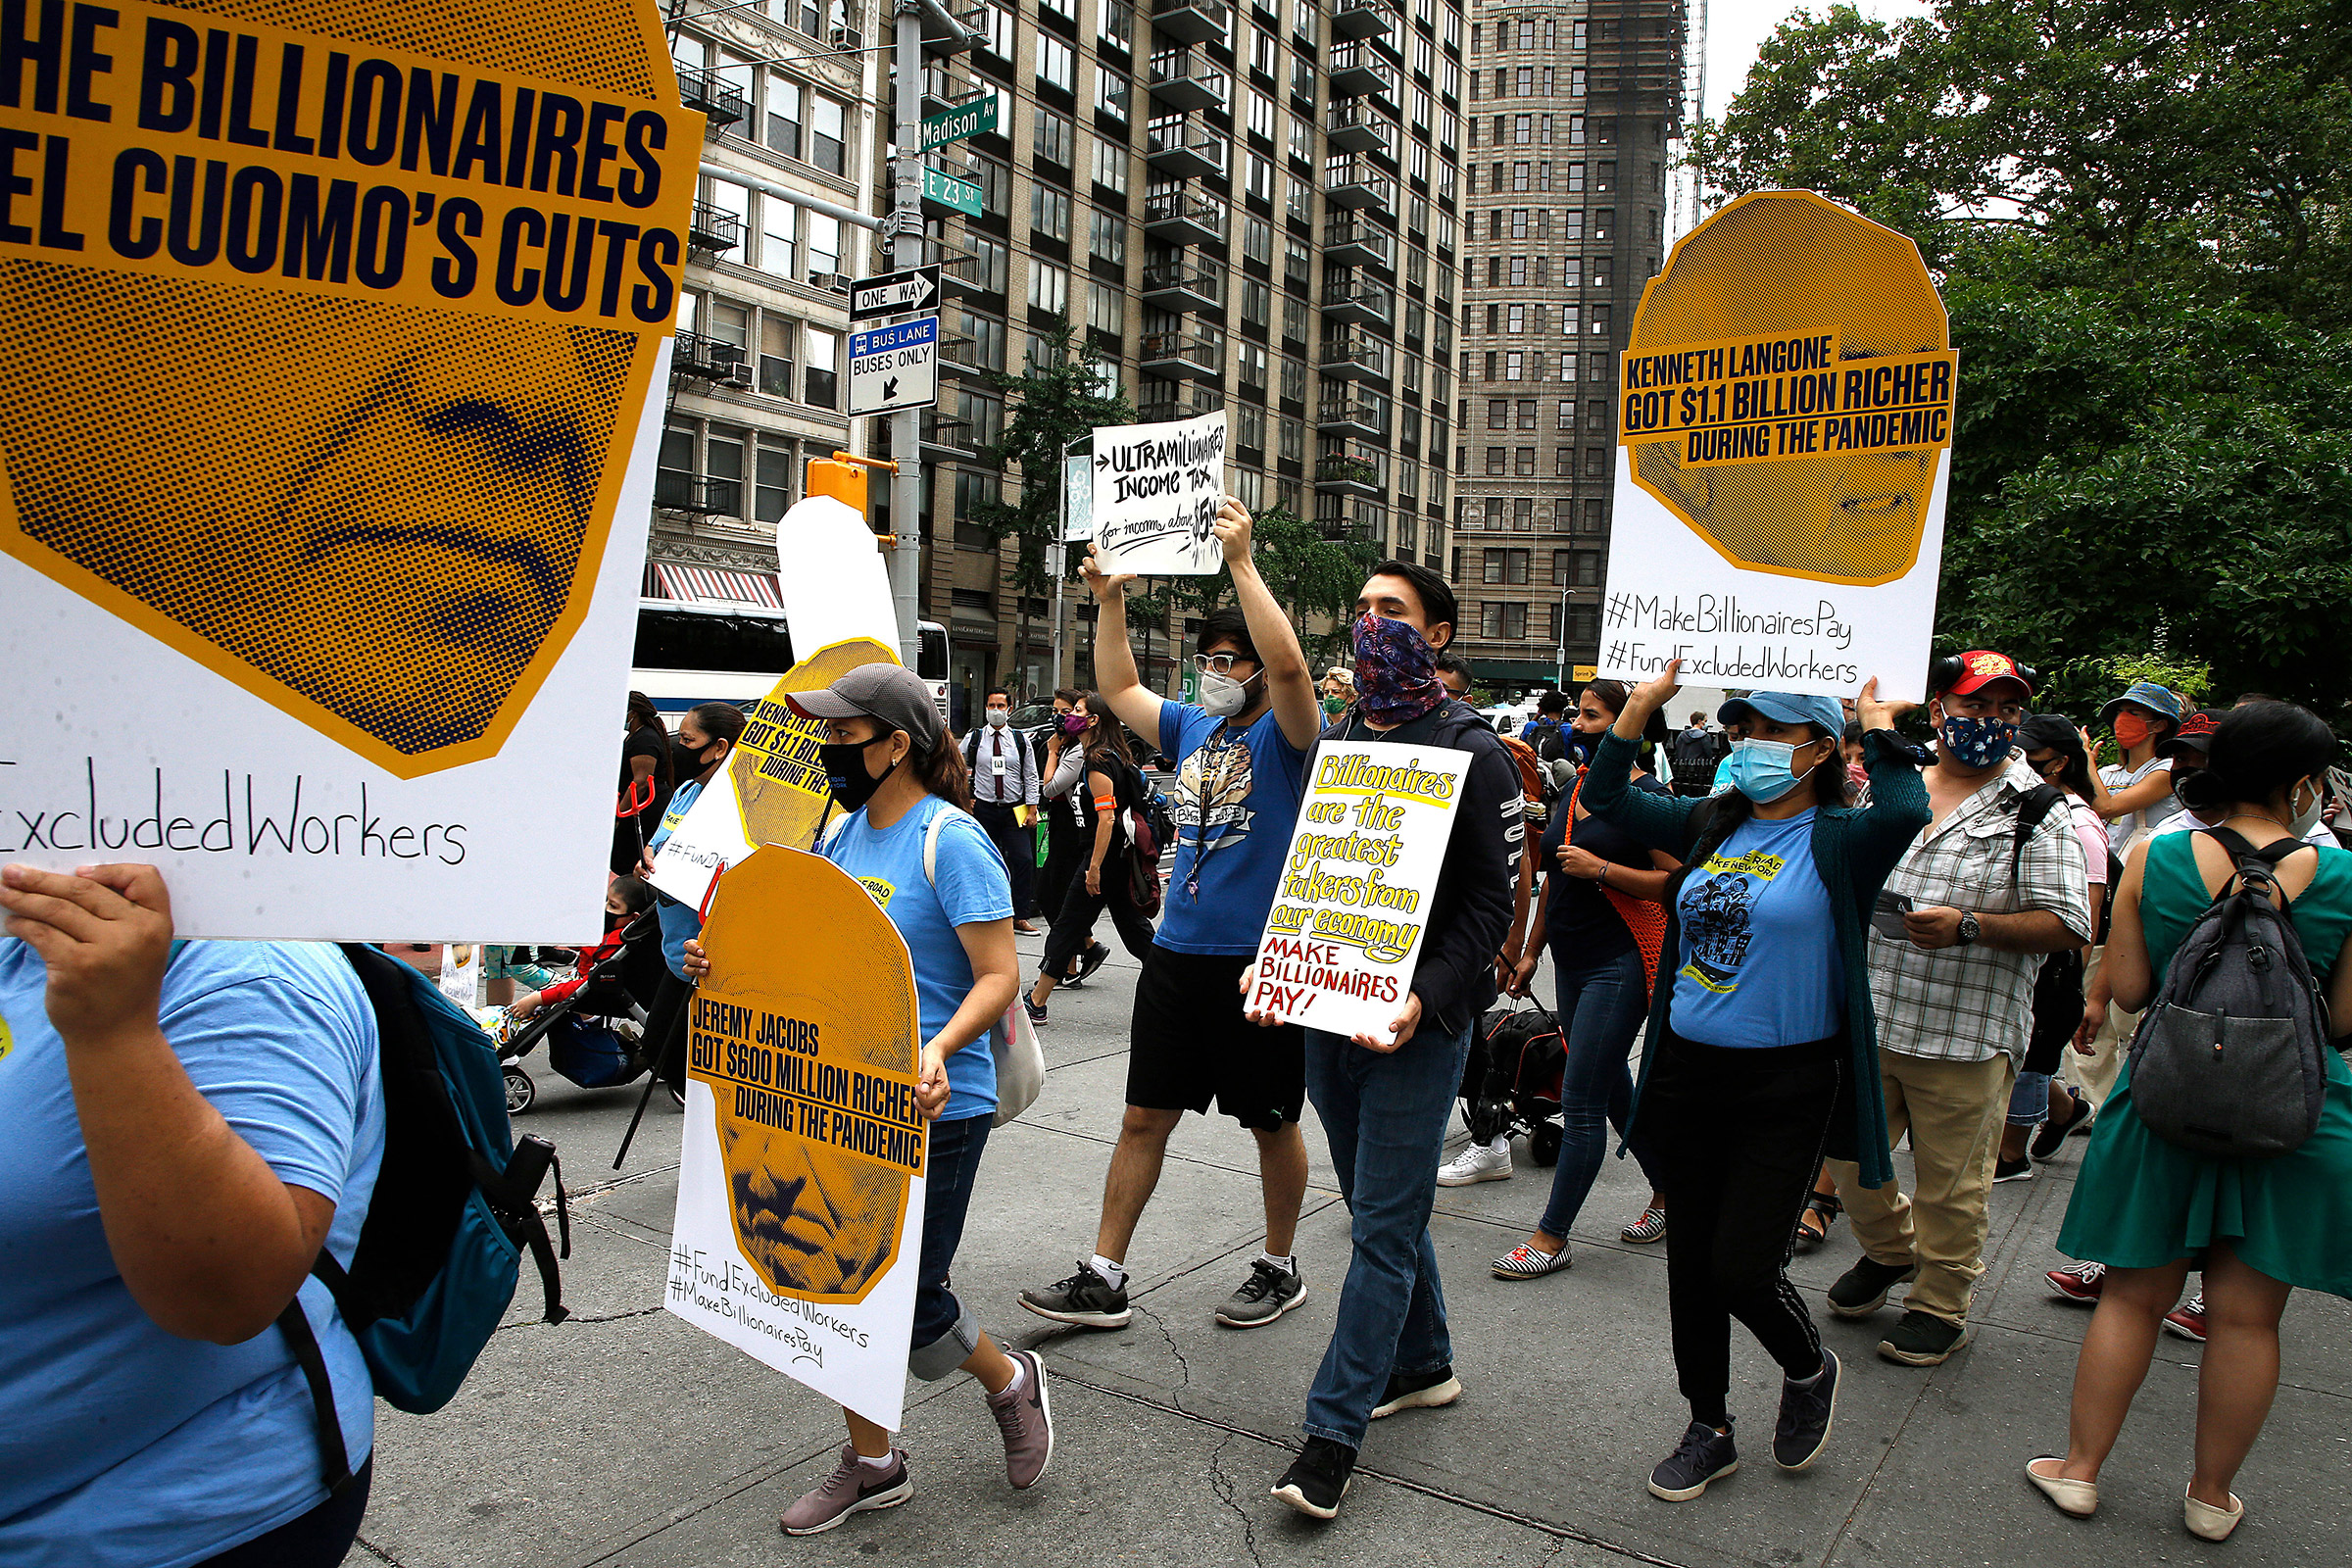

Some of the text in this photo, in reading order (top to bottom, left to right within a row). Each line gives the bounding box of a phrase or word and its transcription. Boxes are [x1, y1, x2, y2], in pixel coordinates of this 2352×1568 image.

[137, 16, 668, 210] BILLIONAIRES
[922, 102, 996, 146] Madison Av
[929, 175, 975, 205] E 23 St
[108, 147, 483, 300] CUOMO'S
[494, 207, 680, 323] CUTS
[861, 281, 926, 308] ONE WAY
[872, 324, 931, 349] BUS LANE
[854, 345, 931, 376] BUSES ONLY
[1626, 334, 1833, 390] KENNETH LANGONE
[1625, 360, 1952, 431] GOT $1.1 BILLION RICHER
[1688, 409, 1948, 464] DURING THE PANDEMIC
[1186, 465, 1211, 493] TAX
[1098, 520, 1121, 550] for
[1123, 518, 1166, 535] income
[1606, 592, 1852, 650] #MakeBillionairesPay
[1606, 640, 1858, 684] #FundExcludedWorkers
[755, 700, 807, 733] KENNETH
[742, 720, 777, 748] GOT
[769, 728, 802, 758] $1.1
[759, 755, 827, 794] DURING THE
[1314, 754, 1457, 801] Billionaires
[1305, 793, 1406, 831] are the
[1290, 831, 1403, 871] greatest
[1752, 855, 1783, 870] RAD
[866, 880, 890, 898] ROAD
[1282, 860, 1421, 914] takers from
[1263, 936, 1341, 966] MAKE
[1271, 904, 1421, 957] our economy
[1259, 956, 1398, 1003] BILLIONAIRES
[692, 997, 819, 1057] JEREMY JACOBS
[691, 1031, 724, 1072] GOT
[726, 1039, 773, 1086] $600
[775, 1052, 849, 1106] MILLION
[734, 1084, 922, 1169] DURING THE PANDEMIC
[673, 1243, 870, 1348] #FundExcludedWorkers
[668, 1275, 823, 1369] #MakeBillionairesPay
